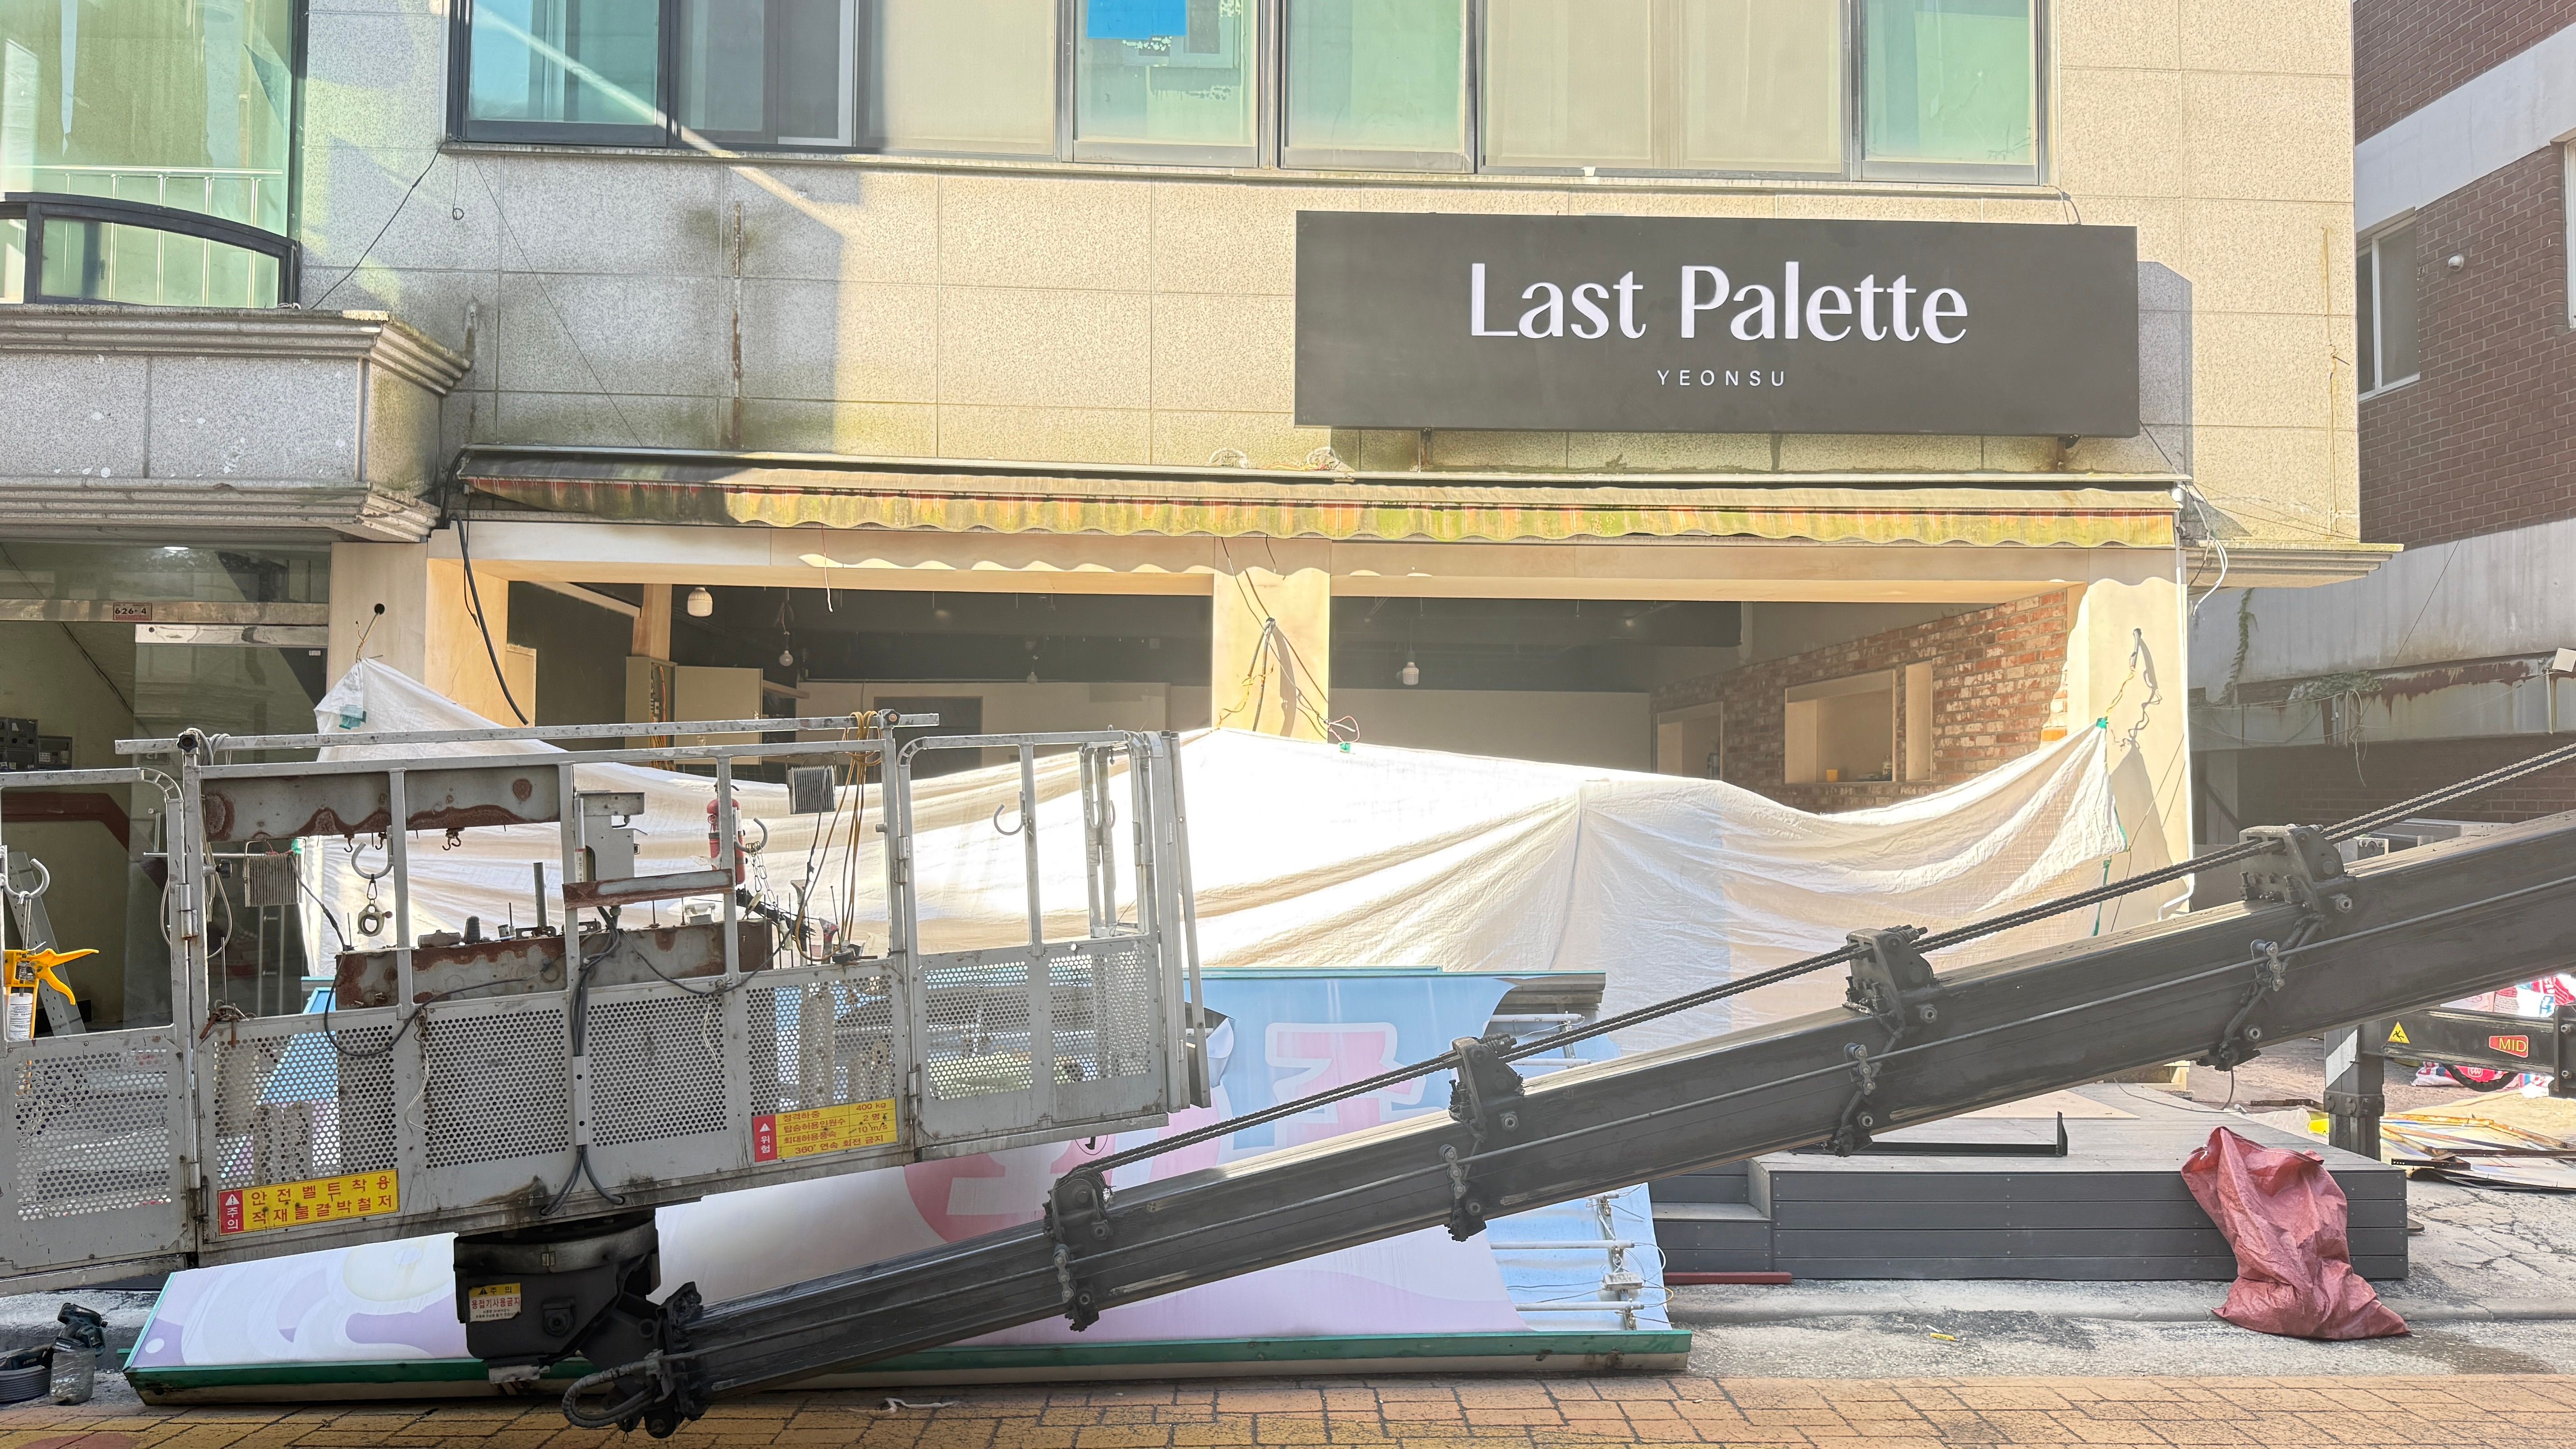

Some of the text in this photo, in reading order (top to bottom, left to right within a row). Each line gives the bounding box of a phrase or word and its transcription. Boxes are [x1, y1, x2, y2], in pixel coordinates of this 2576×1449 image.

[1472, 261, 1968, 344] Last Palette
[1657, 370, 1785, 387] YEONSU
[2499, 1037, 2526, 1052] MID
[783, 1111, 820, 1122] 정격하중
[784, 1130, 837, 1144] 최대허용풍속
[820, 1141, 838, 1150] 연속
[843, 1138, 860, 1147] 회전
[865, 1135, 883, 1144] 금지
[227, 1207, 239, 1230] 주의
